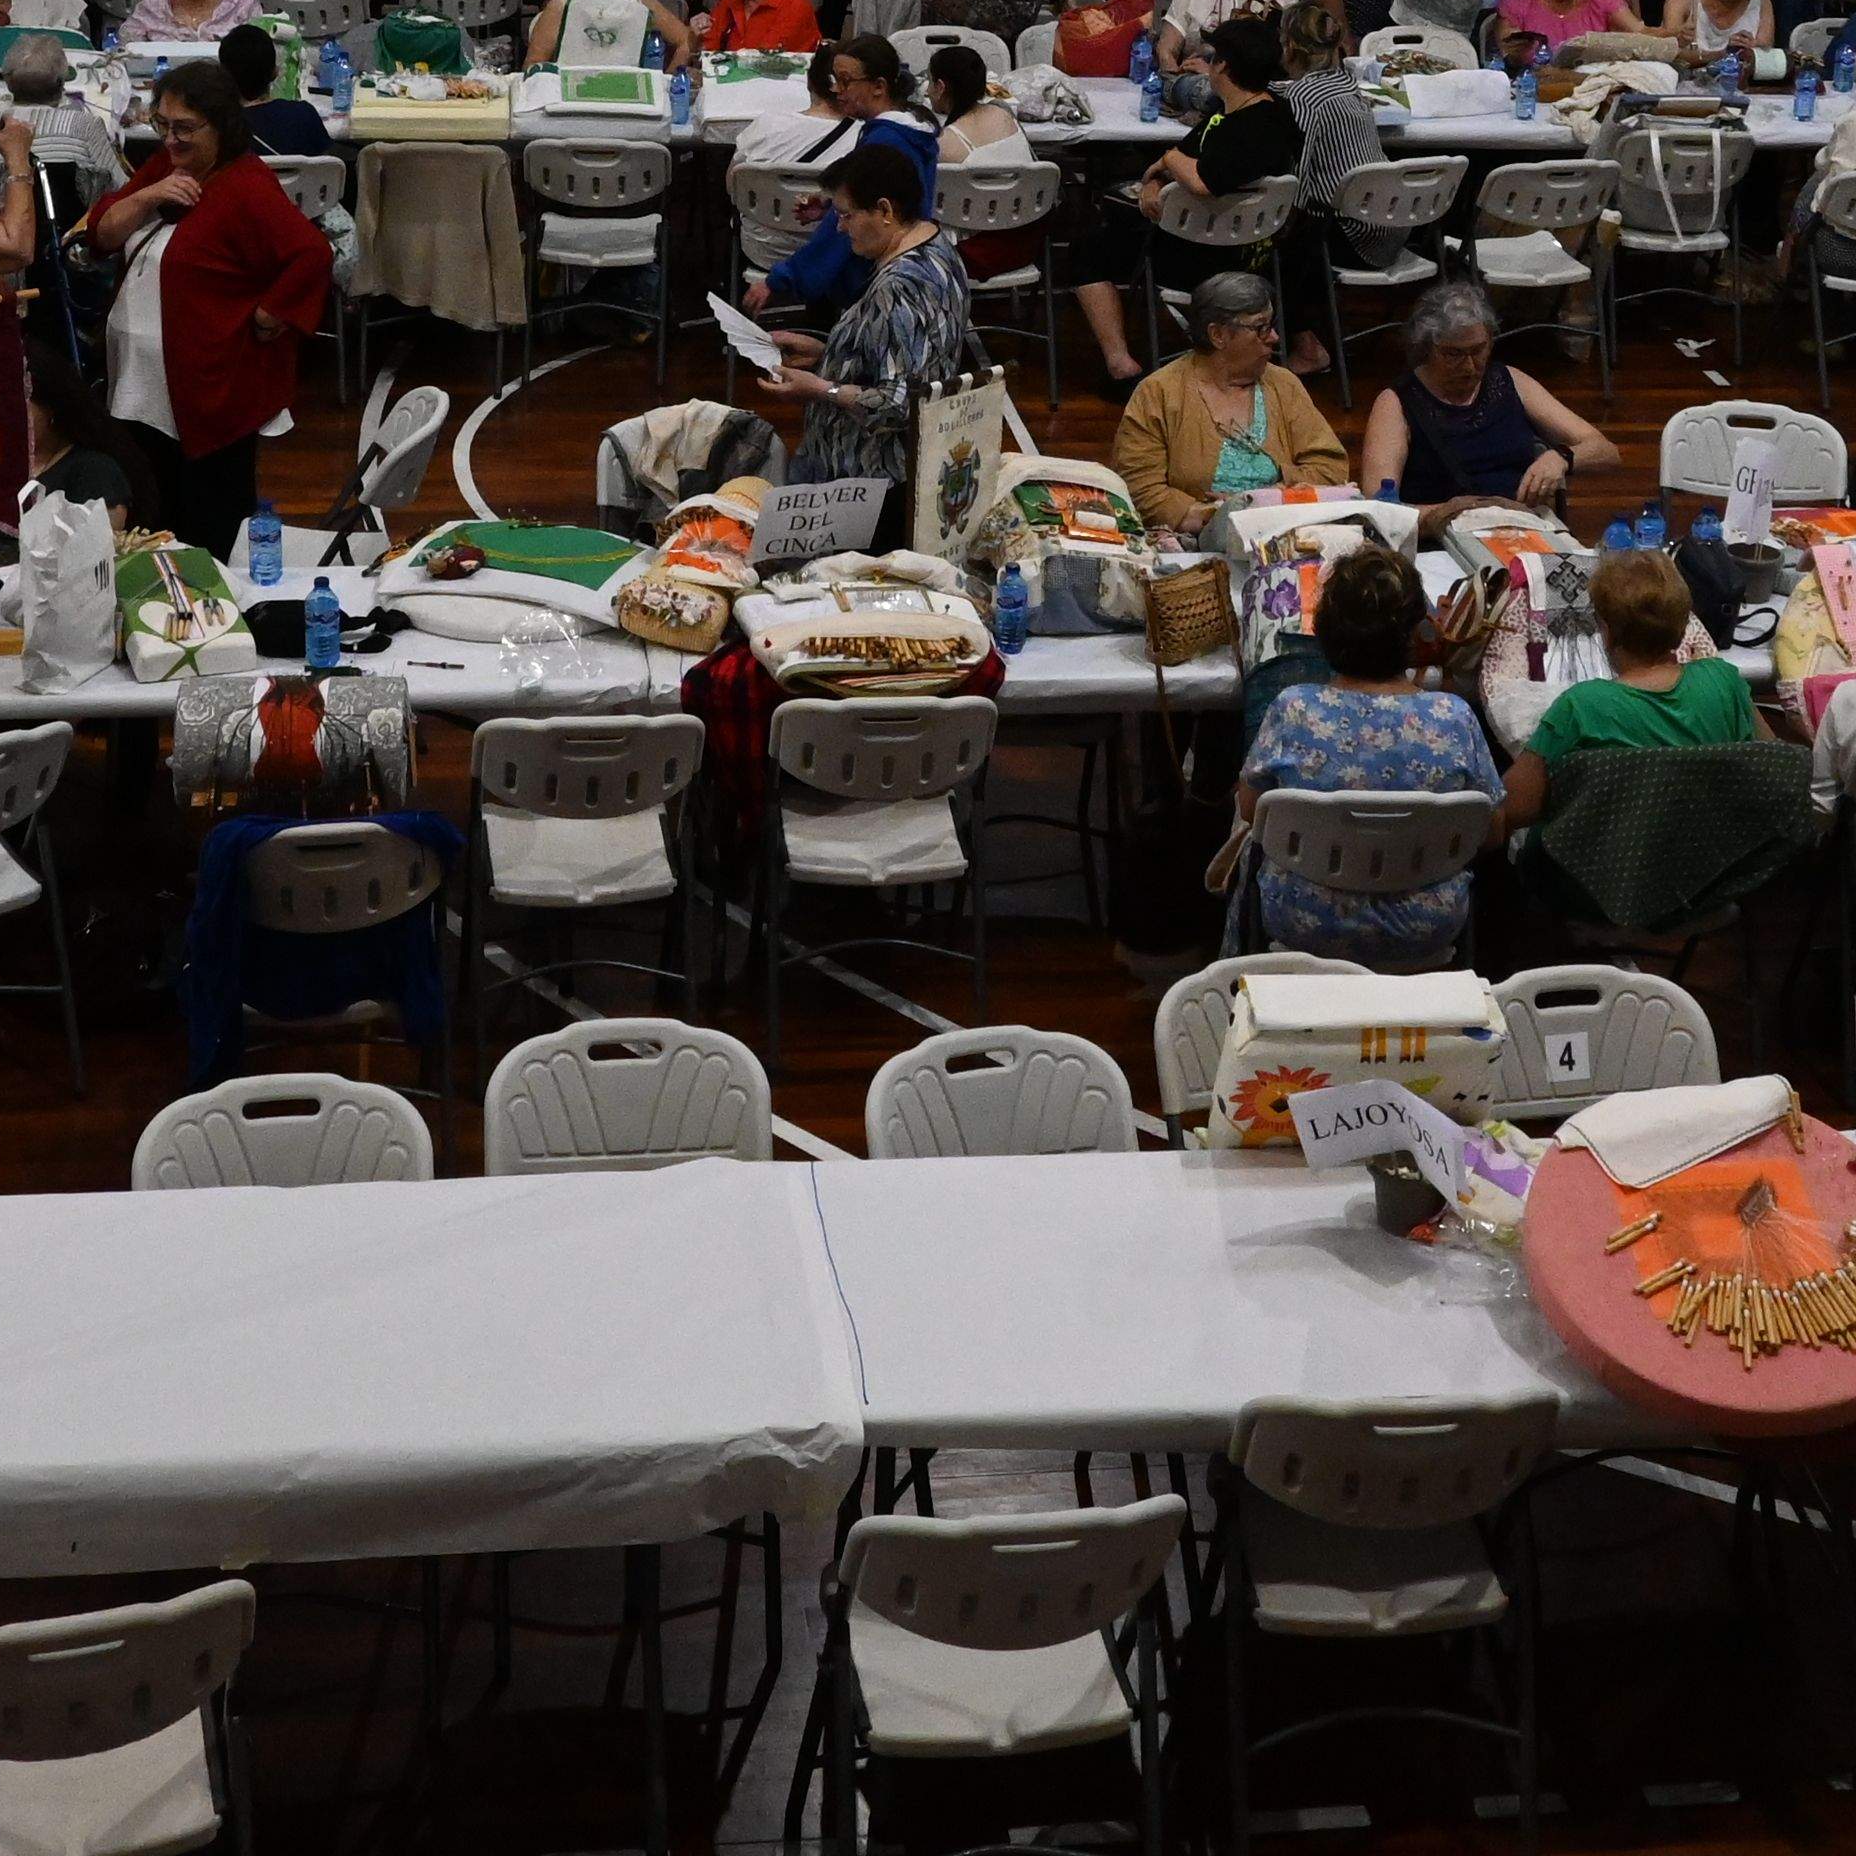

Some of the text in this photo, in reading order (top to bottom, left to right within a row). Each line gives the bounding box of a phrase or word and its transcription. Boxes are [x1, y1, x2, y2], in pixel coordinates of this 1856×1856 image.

[777, 487, 867, 511] BELVER
[788, 511, 833, 530] DEL
[765, 531, 836, 554] CINCA
[1559, 1041, 1575, 1071] 4
